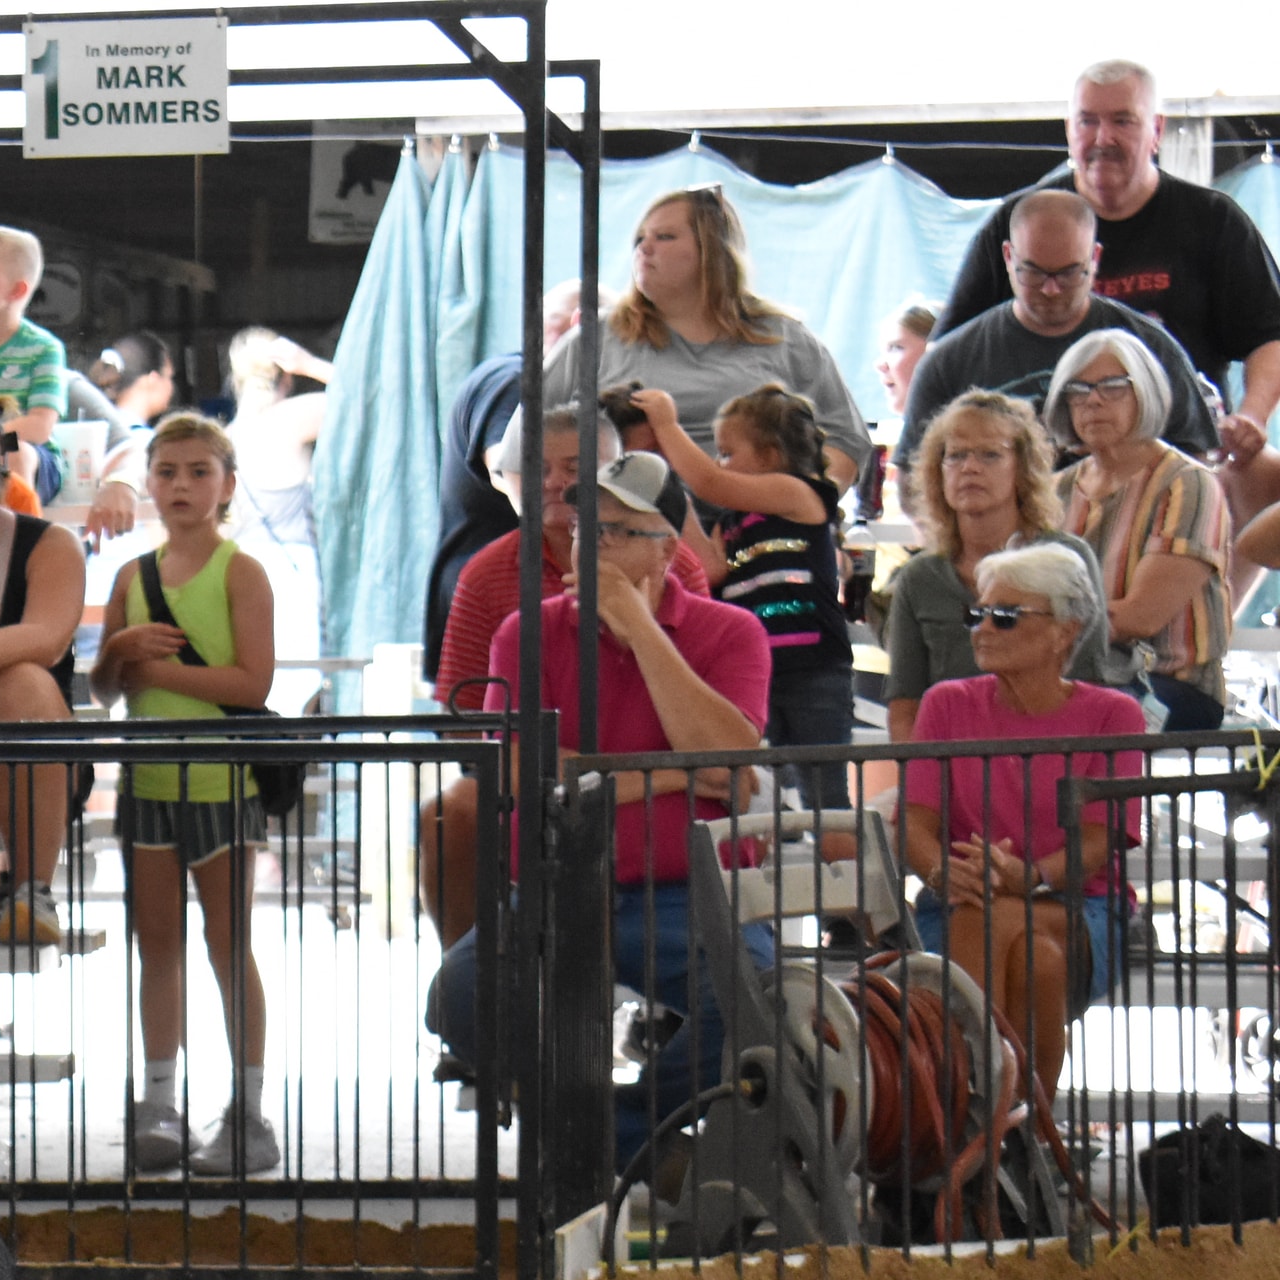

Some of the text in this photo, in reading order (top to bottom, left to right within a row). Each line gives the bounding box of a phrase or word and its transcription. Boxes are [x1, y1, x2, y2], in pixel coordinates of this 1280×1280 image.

[85, 42, 192, 59] In Memory of
[31, 39, 59, 140] 1
[96, 64, 187, 90] MARK
[62, 99, 220, 127] SOMMERS
